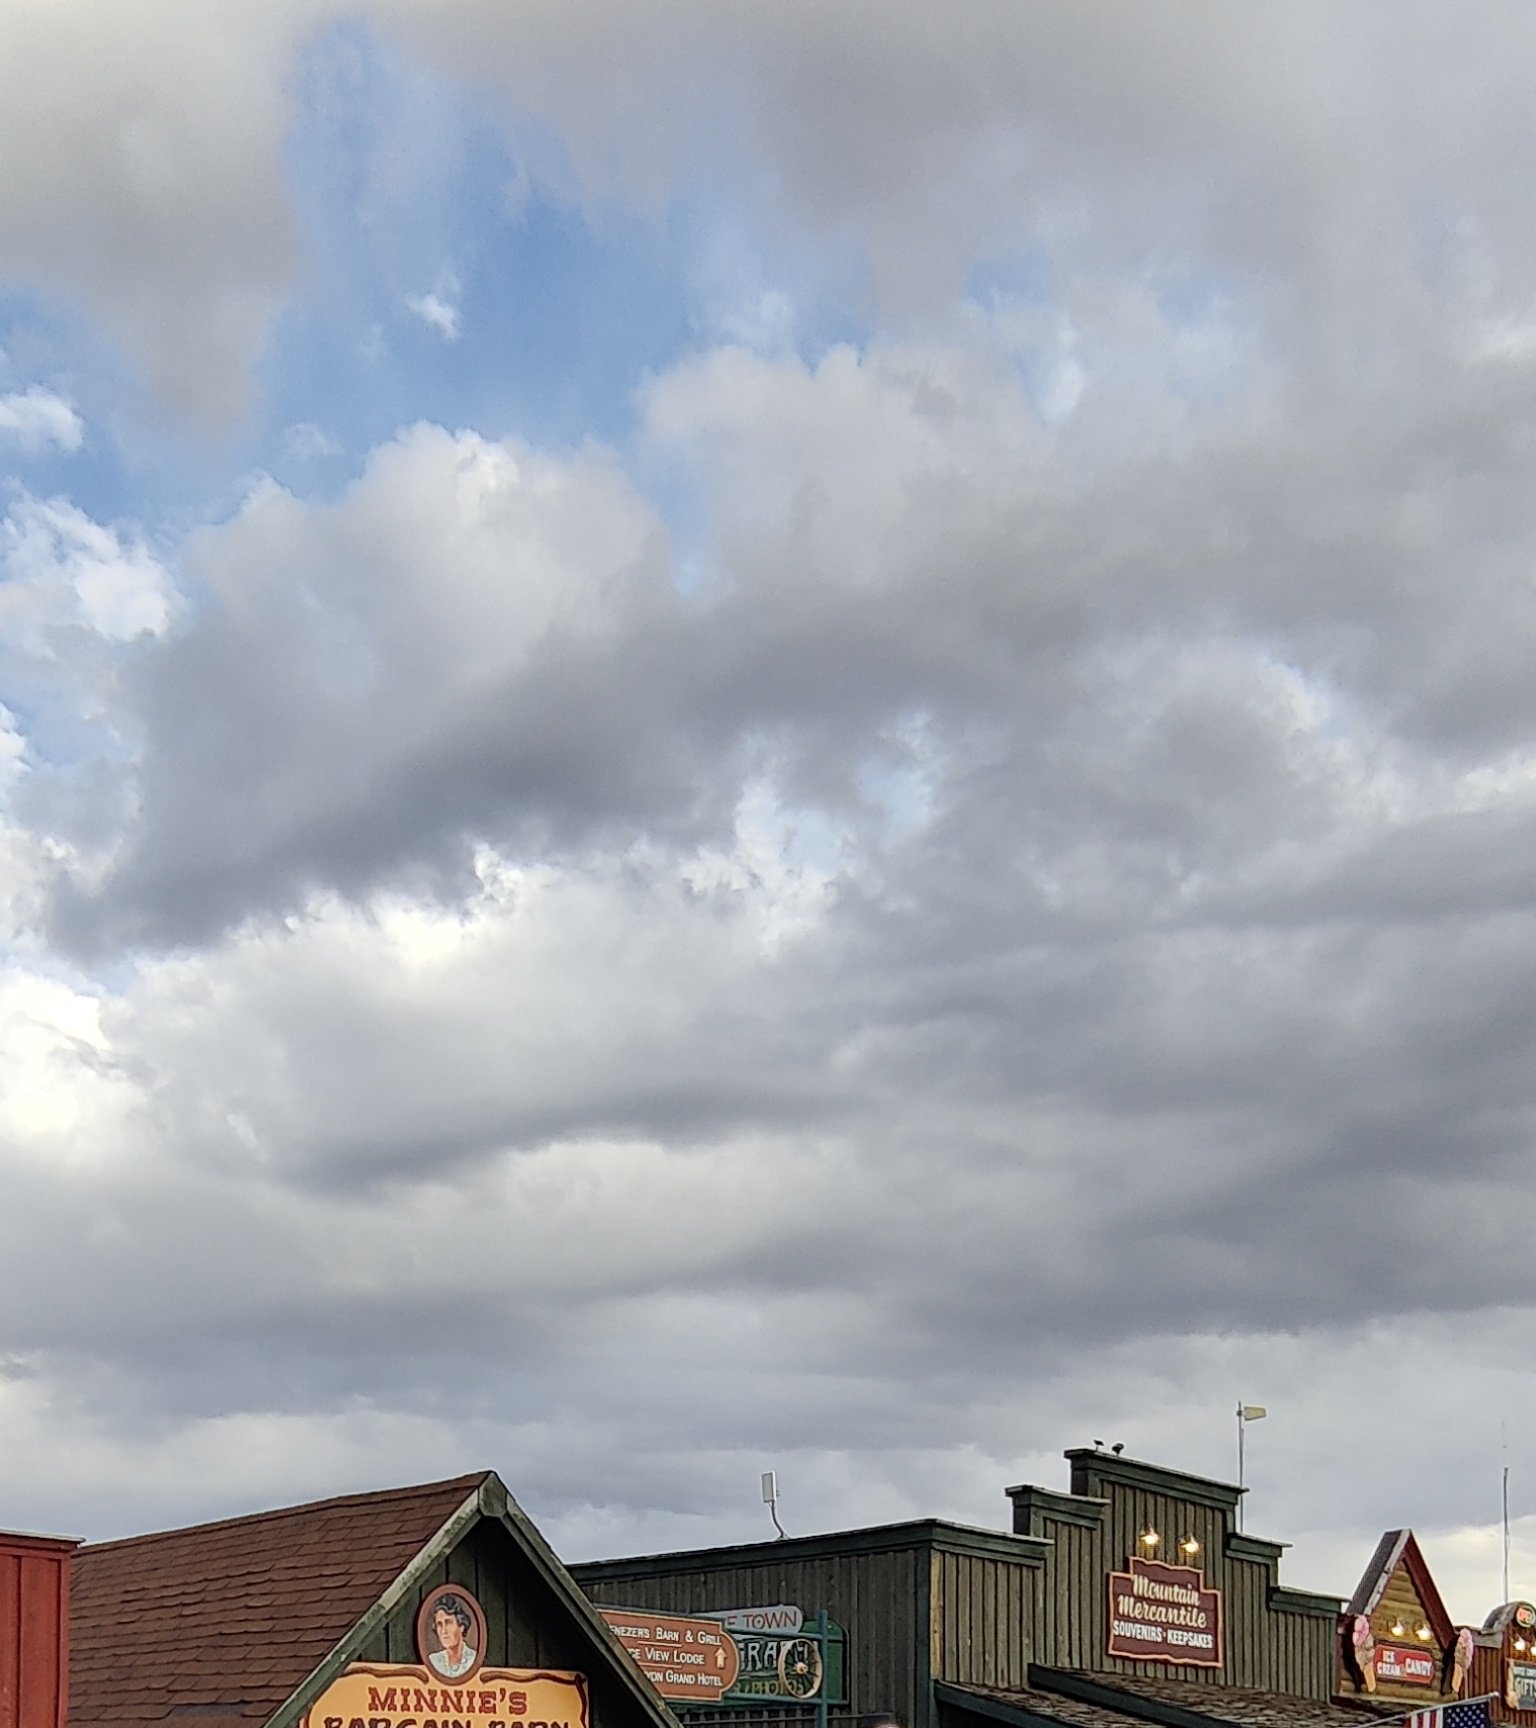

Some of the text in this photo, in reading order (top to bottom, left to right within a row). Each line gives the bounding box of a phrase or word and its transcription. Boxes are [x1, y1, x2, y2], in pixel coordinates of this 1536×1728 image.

[1133, 1574, 1201, 1606] Mountain
[742, 1611, 797, 1629] TOWN
[1117, 1595, 1207, 1628] Mercantile
[685, 1630, 694, 1642] &
[1113, 1620, 1213, 1649] SOUVENIRS KEEPSAKES
[1406, 1658, 1432, 1676] CANDY
[368, 1687, 527, 1714] MINNIE'S
